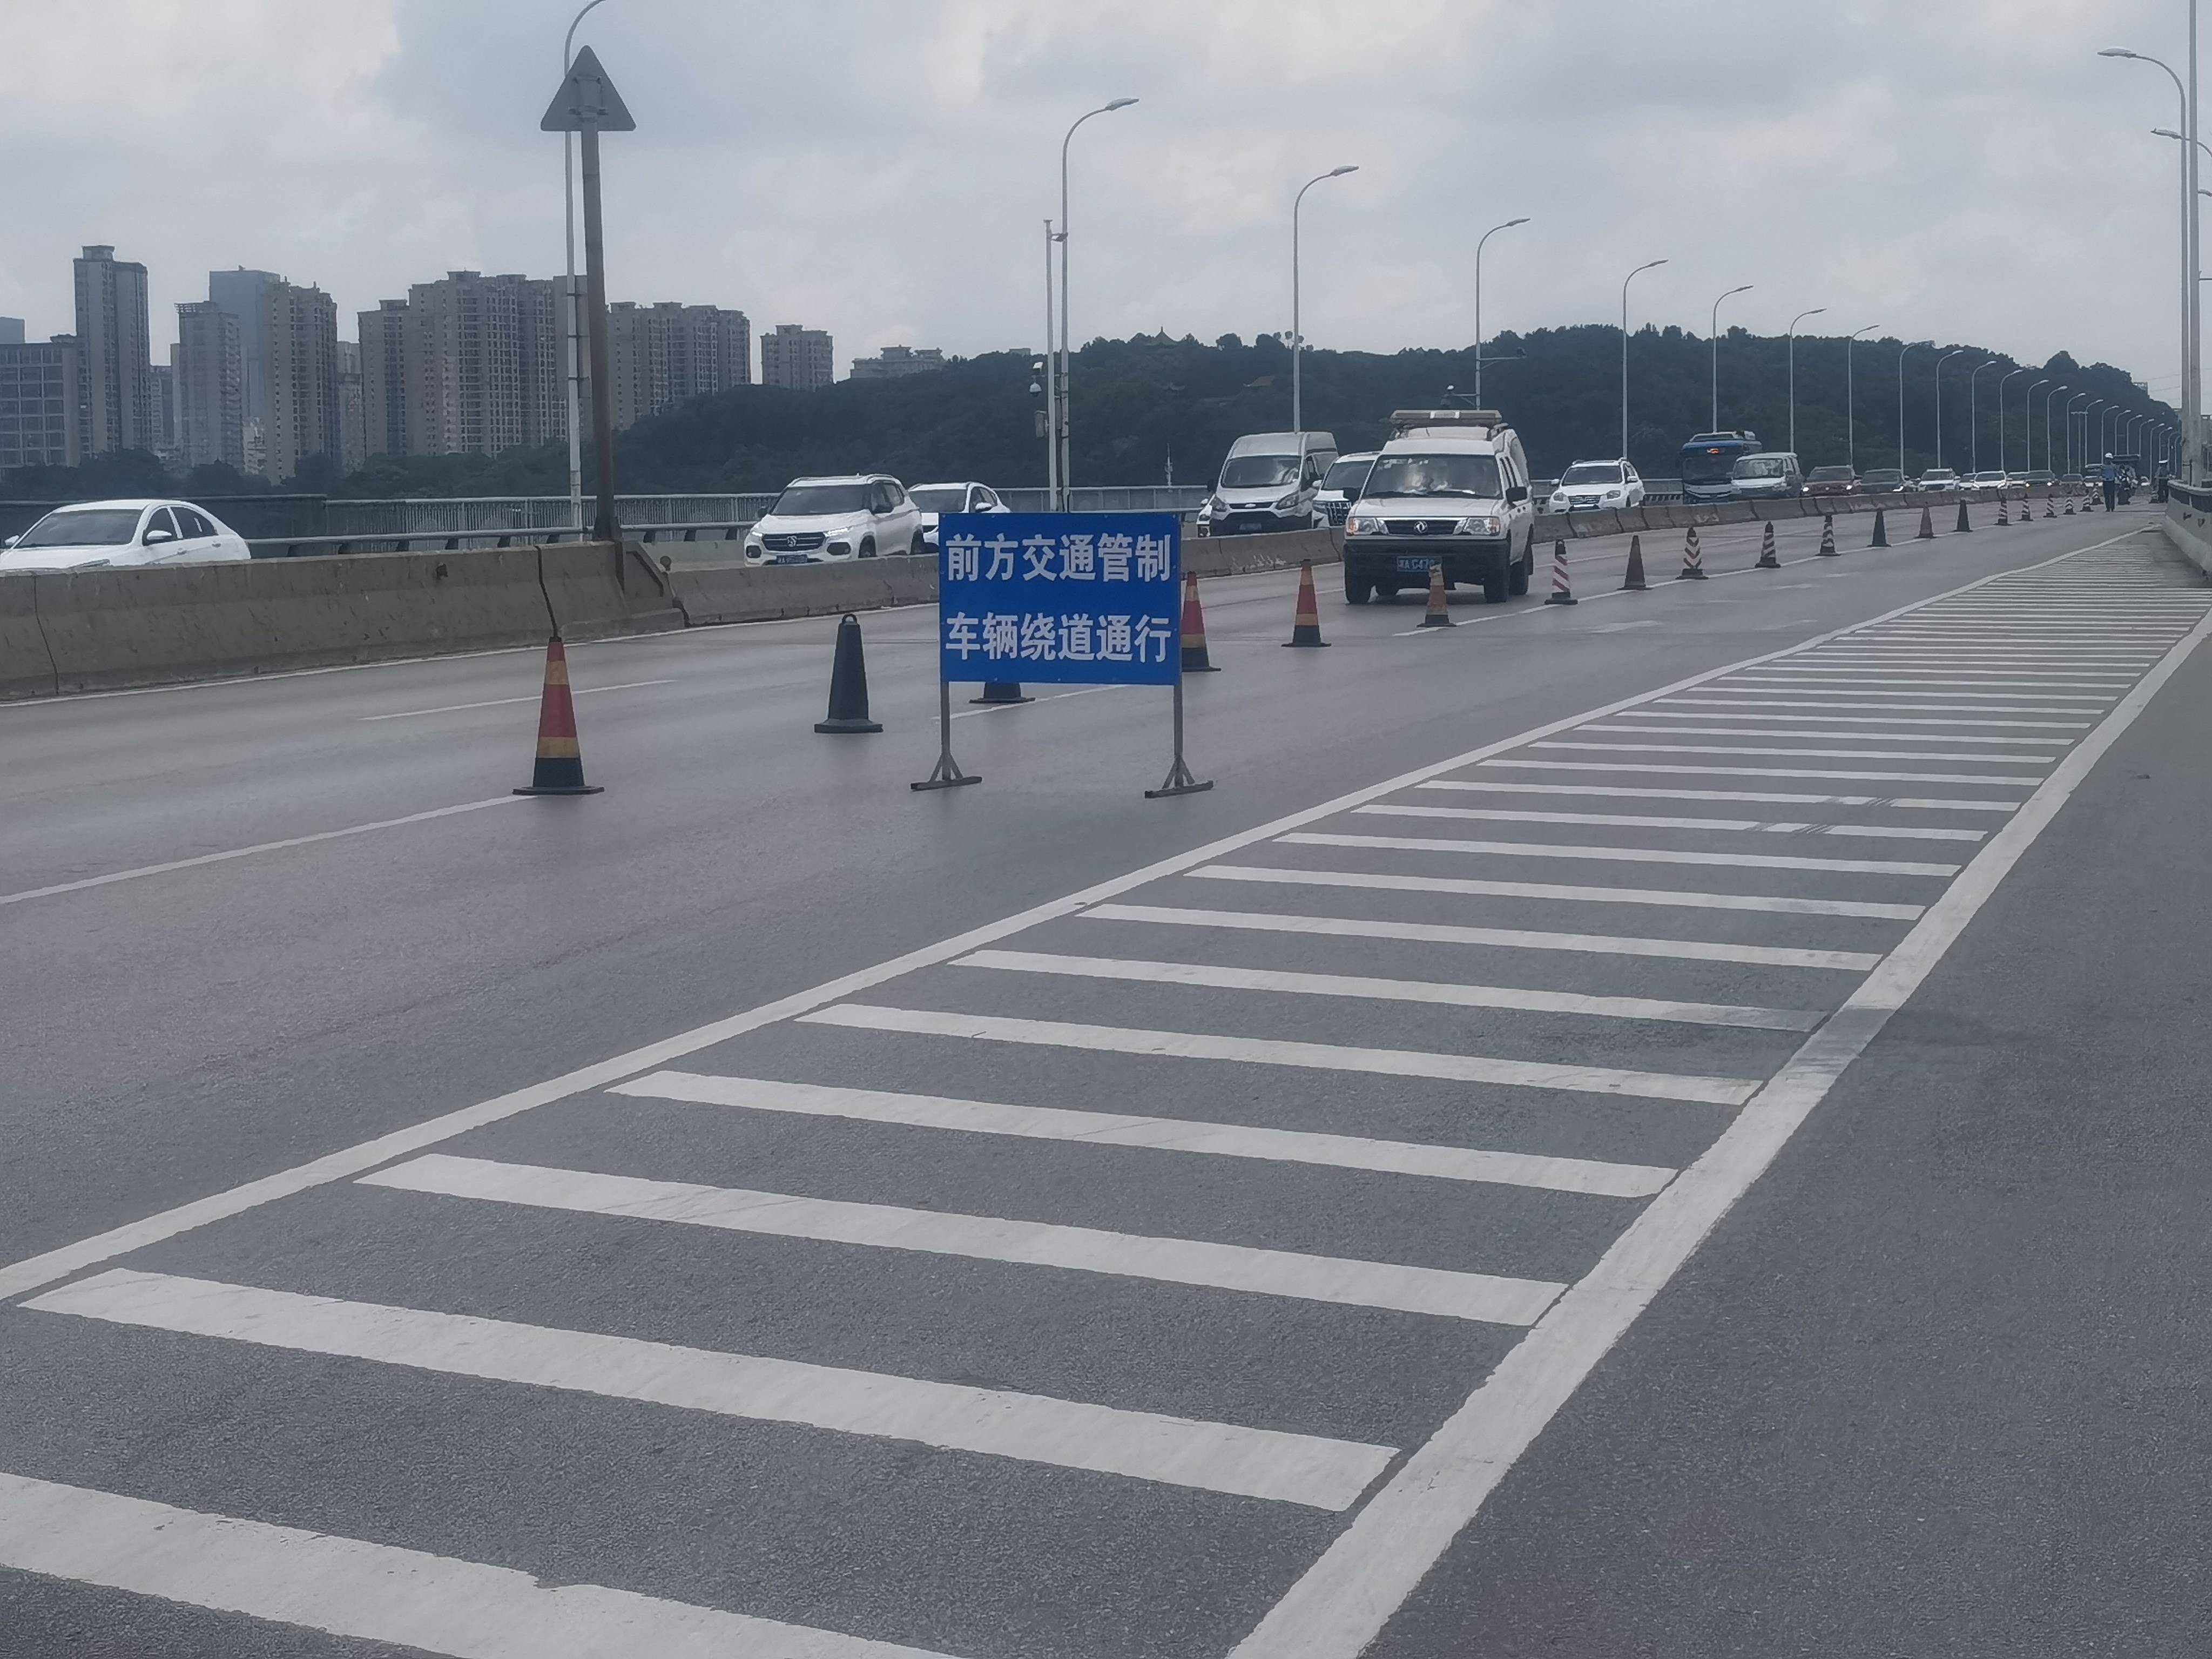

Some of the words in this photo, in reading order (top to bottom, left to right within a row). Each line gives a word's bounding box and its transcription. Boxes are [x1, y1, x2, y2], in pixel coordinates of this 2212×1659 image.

[946, 533, 1171, 582] 前方交通管制
[946, 611, 1171, 663] 车辆绕道通行
